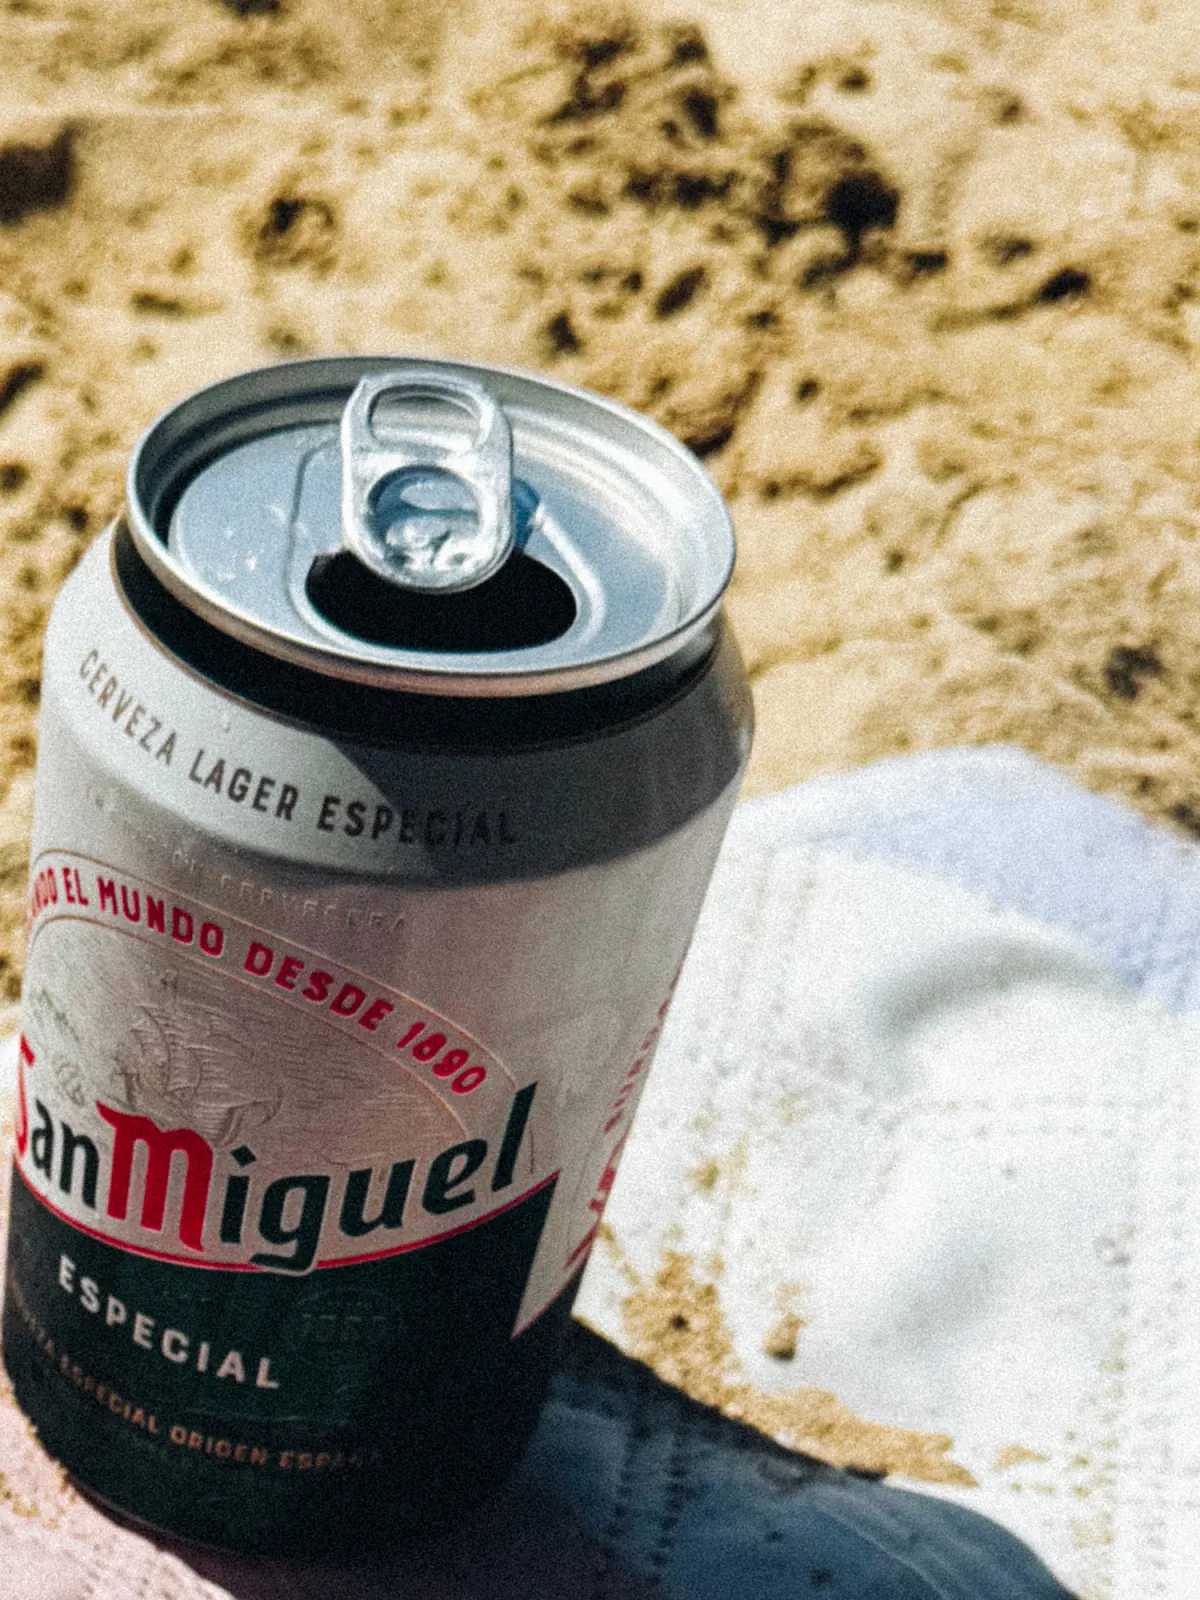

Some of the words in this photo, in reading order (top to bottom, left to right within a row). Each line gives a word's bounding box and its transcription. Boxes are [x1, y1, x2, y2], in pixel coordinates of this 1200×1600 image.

[77, 648, 177, 768] CERVEZA
[188, 748, 299, 822] LAGER
[316, 795, 517, 847] ESPECIAL
[62, 866, 89, 907] EL
[96, 875, 225, 957] MUNDO
[243, 940, 396, 1032] DESDE
[395, 1020, 488, 1096] 1890
[58, 1253, 281, 1390] ESPECIAL
